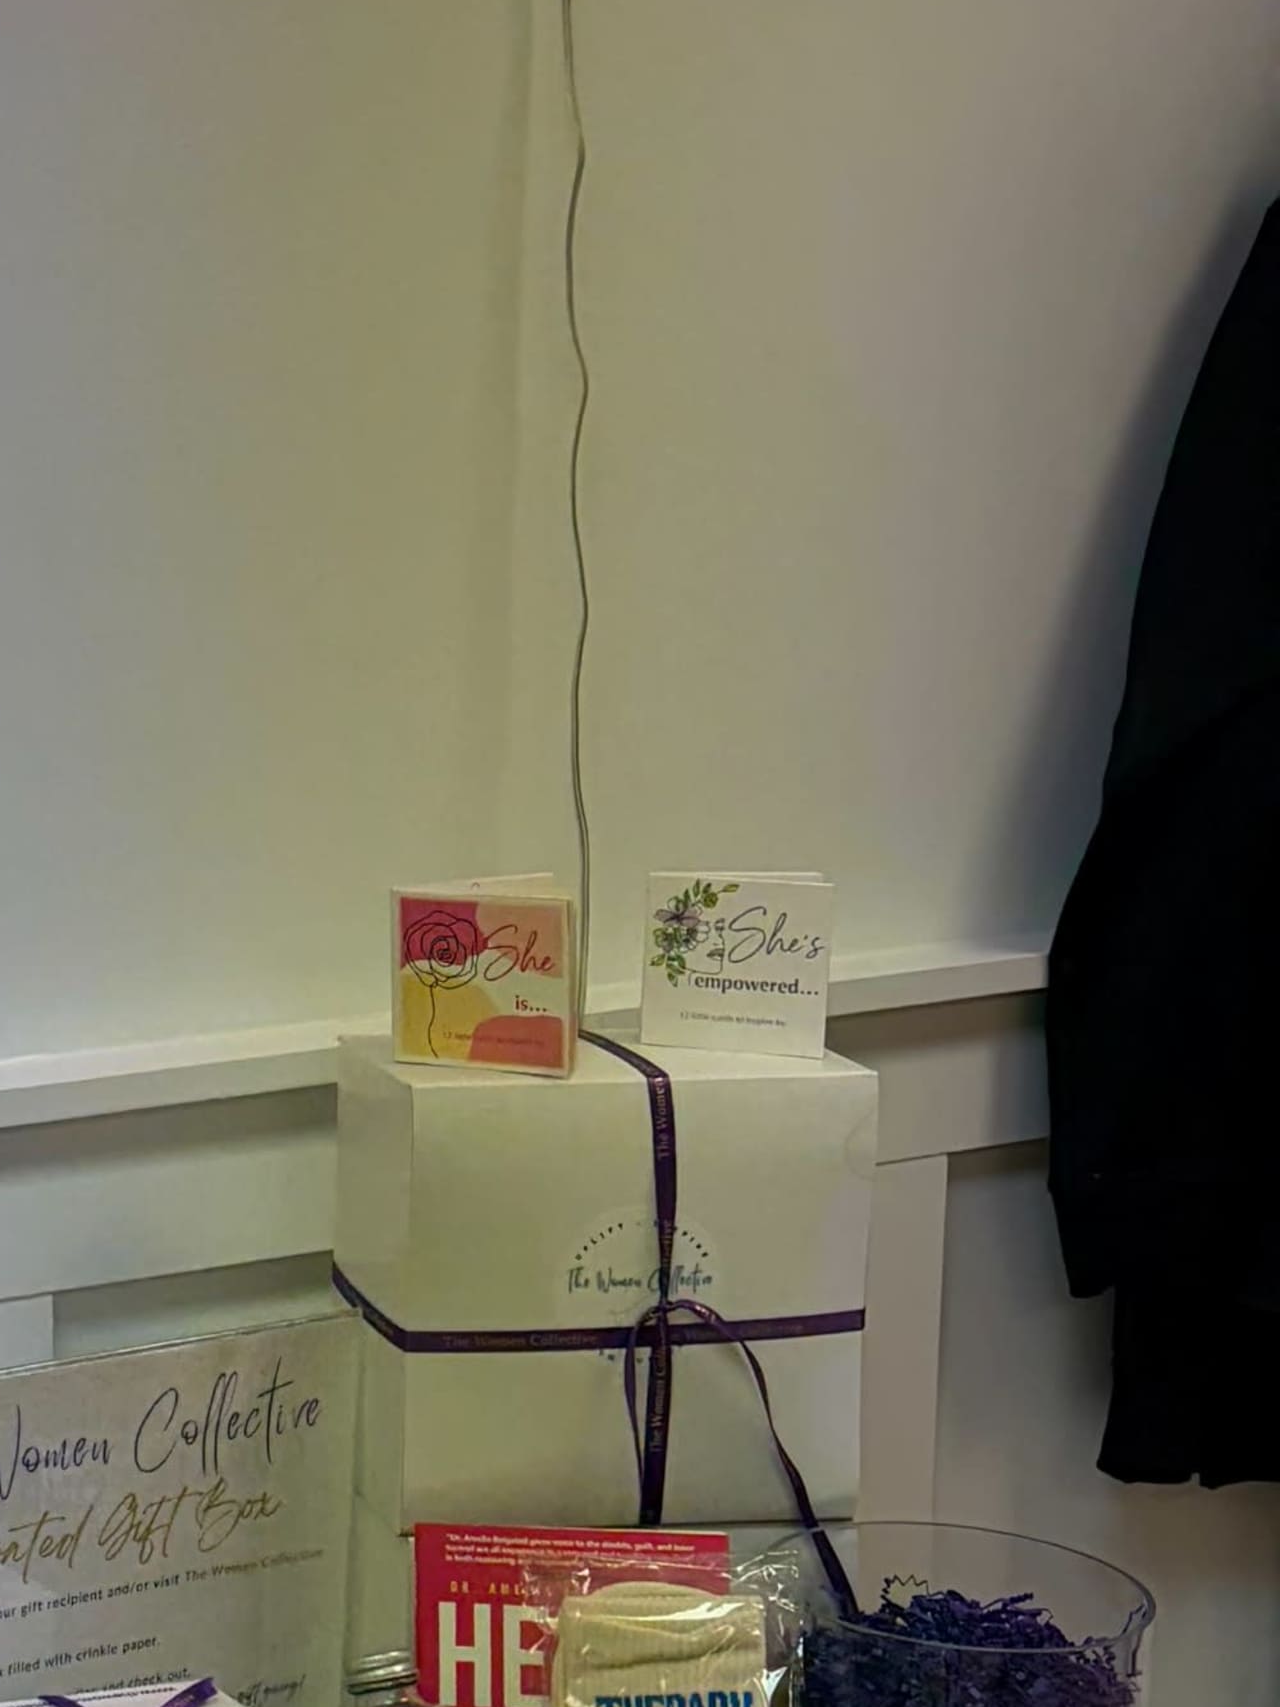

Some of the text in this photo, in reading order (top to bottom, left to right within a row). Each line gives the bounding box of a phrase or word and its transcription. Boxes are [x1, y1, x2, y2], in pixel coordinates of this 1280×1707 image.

[483, 923, 555, 982] She
[727, 906, 825, 964] She's
[647, 1262, 714, 1295] Cllective
[133, 1357, 324, 1477] Collective
[97, 1484, 202, 1567] Gift
[194, 1476, 283, 1551] Box
[19, 1597, 45, 1621] gift
[46, 1588, 104, 1618] recipient
[107, 1578, 150, 1601] and/or
[152, 1573, 181, 1590] visit
[7, 1658, 41, 1678] filled
[44, 1653, 73, 1670] with
[75, 1644, 120, 1665] crinkle
